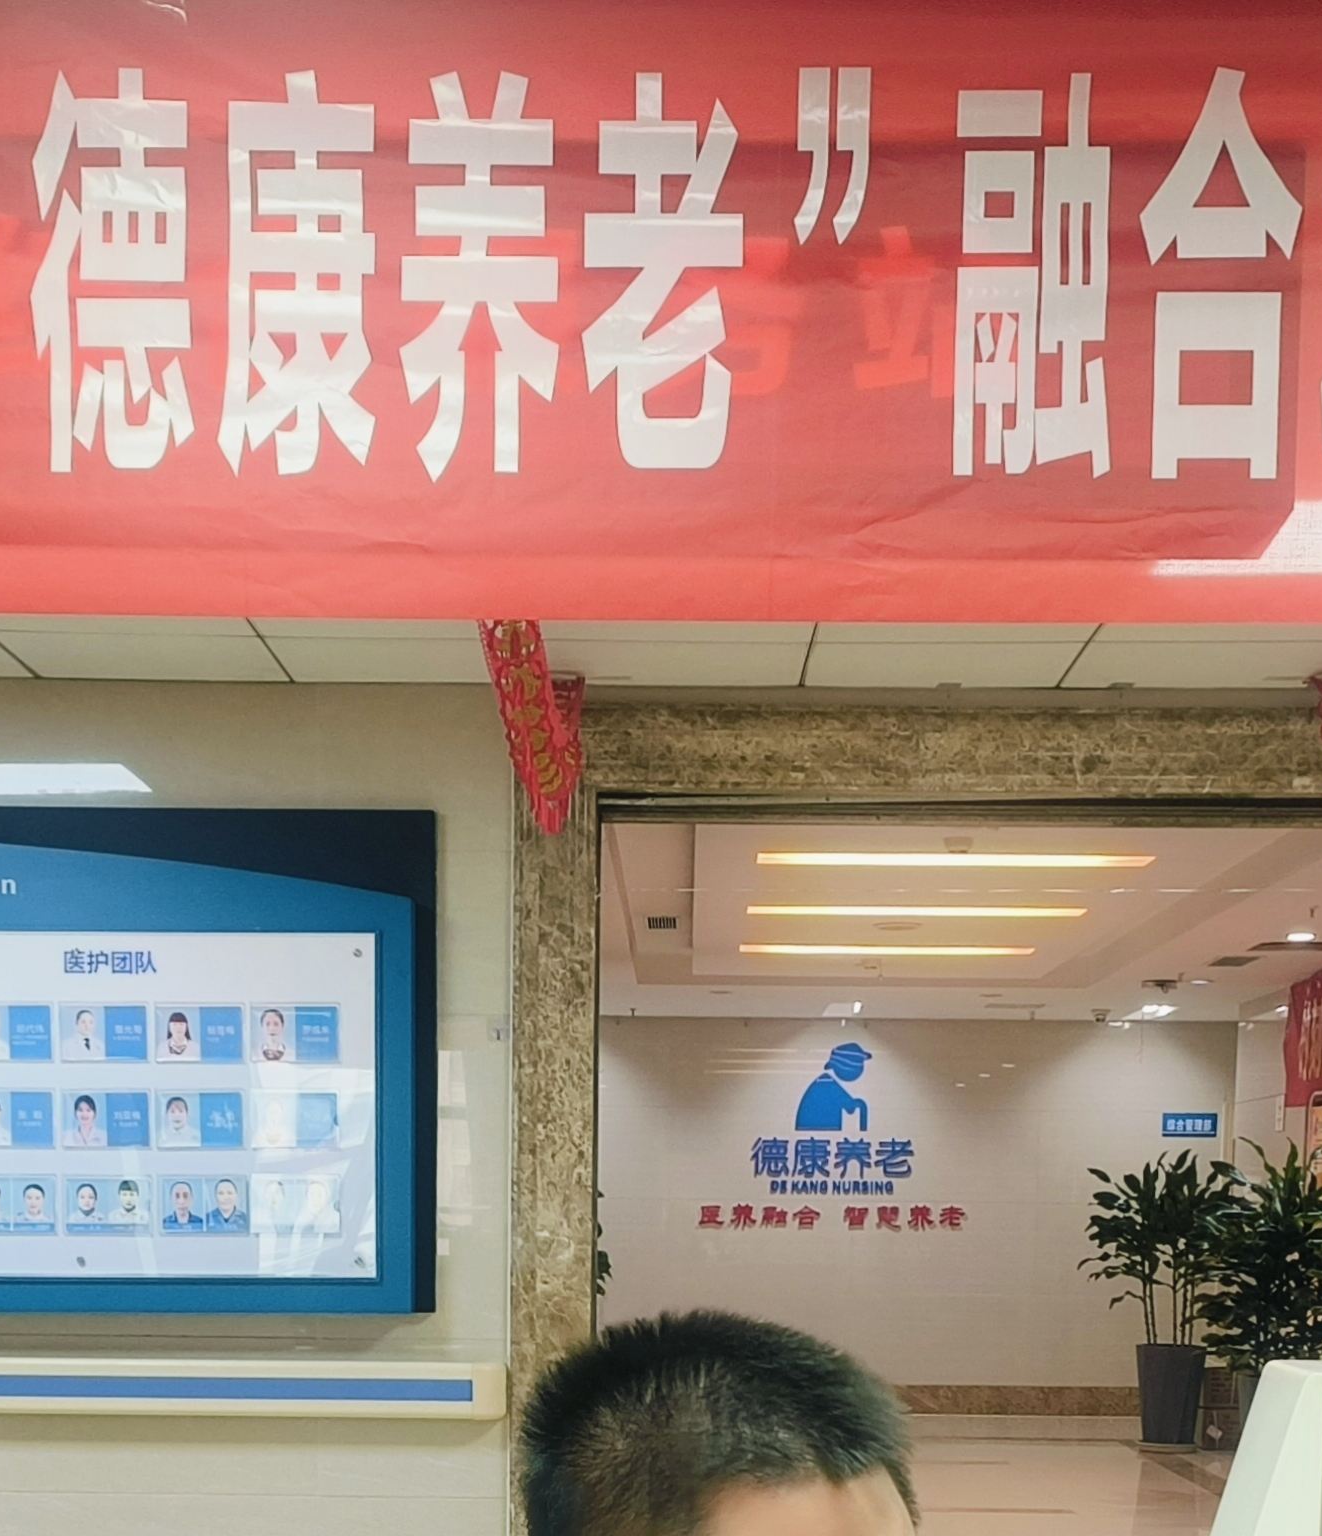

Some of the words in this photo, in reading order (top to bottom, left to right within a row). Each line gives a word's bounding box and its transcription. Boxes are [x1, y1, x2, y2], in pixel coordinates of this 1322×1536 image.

[63, 949, 158, 975] 医护团队
[750, 1137, 915, 1180] 德康养老
[769, 1180, 788, 1196] DE
[790, 1180, 829, 1196] KANG
[832, 1180, 895, 1196] NURSING
[696, 1203, 822, 1231] 医养融合
